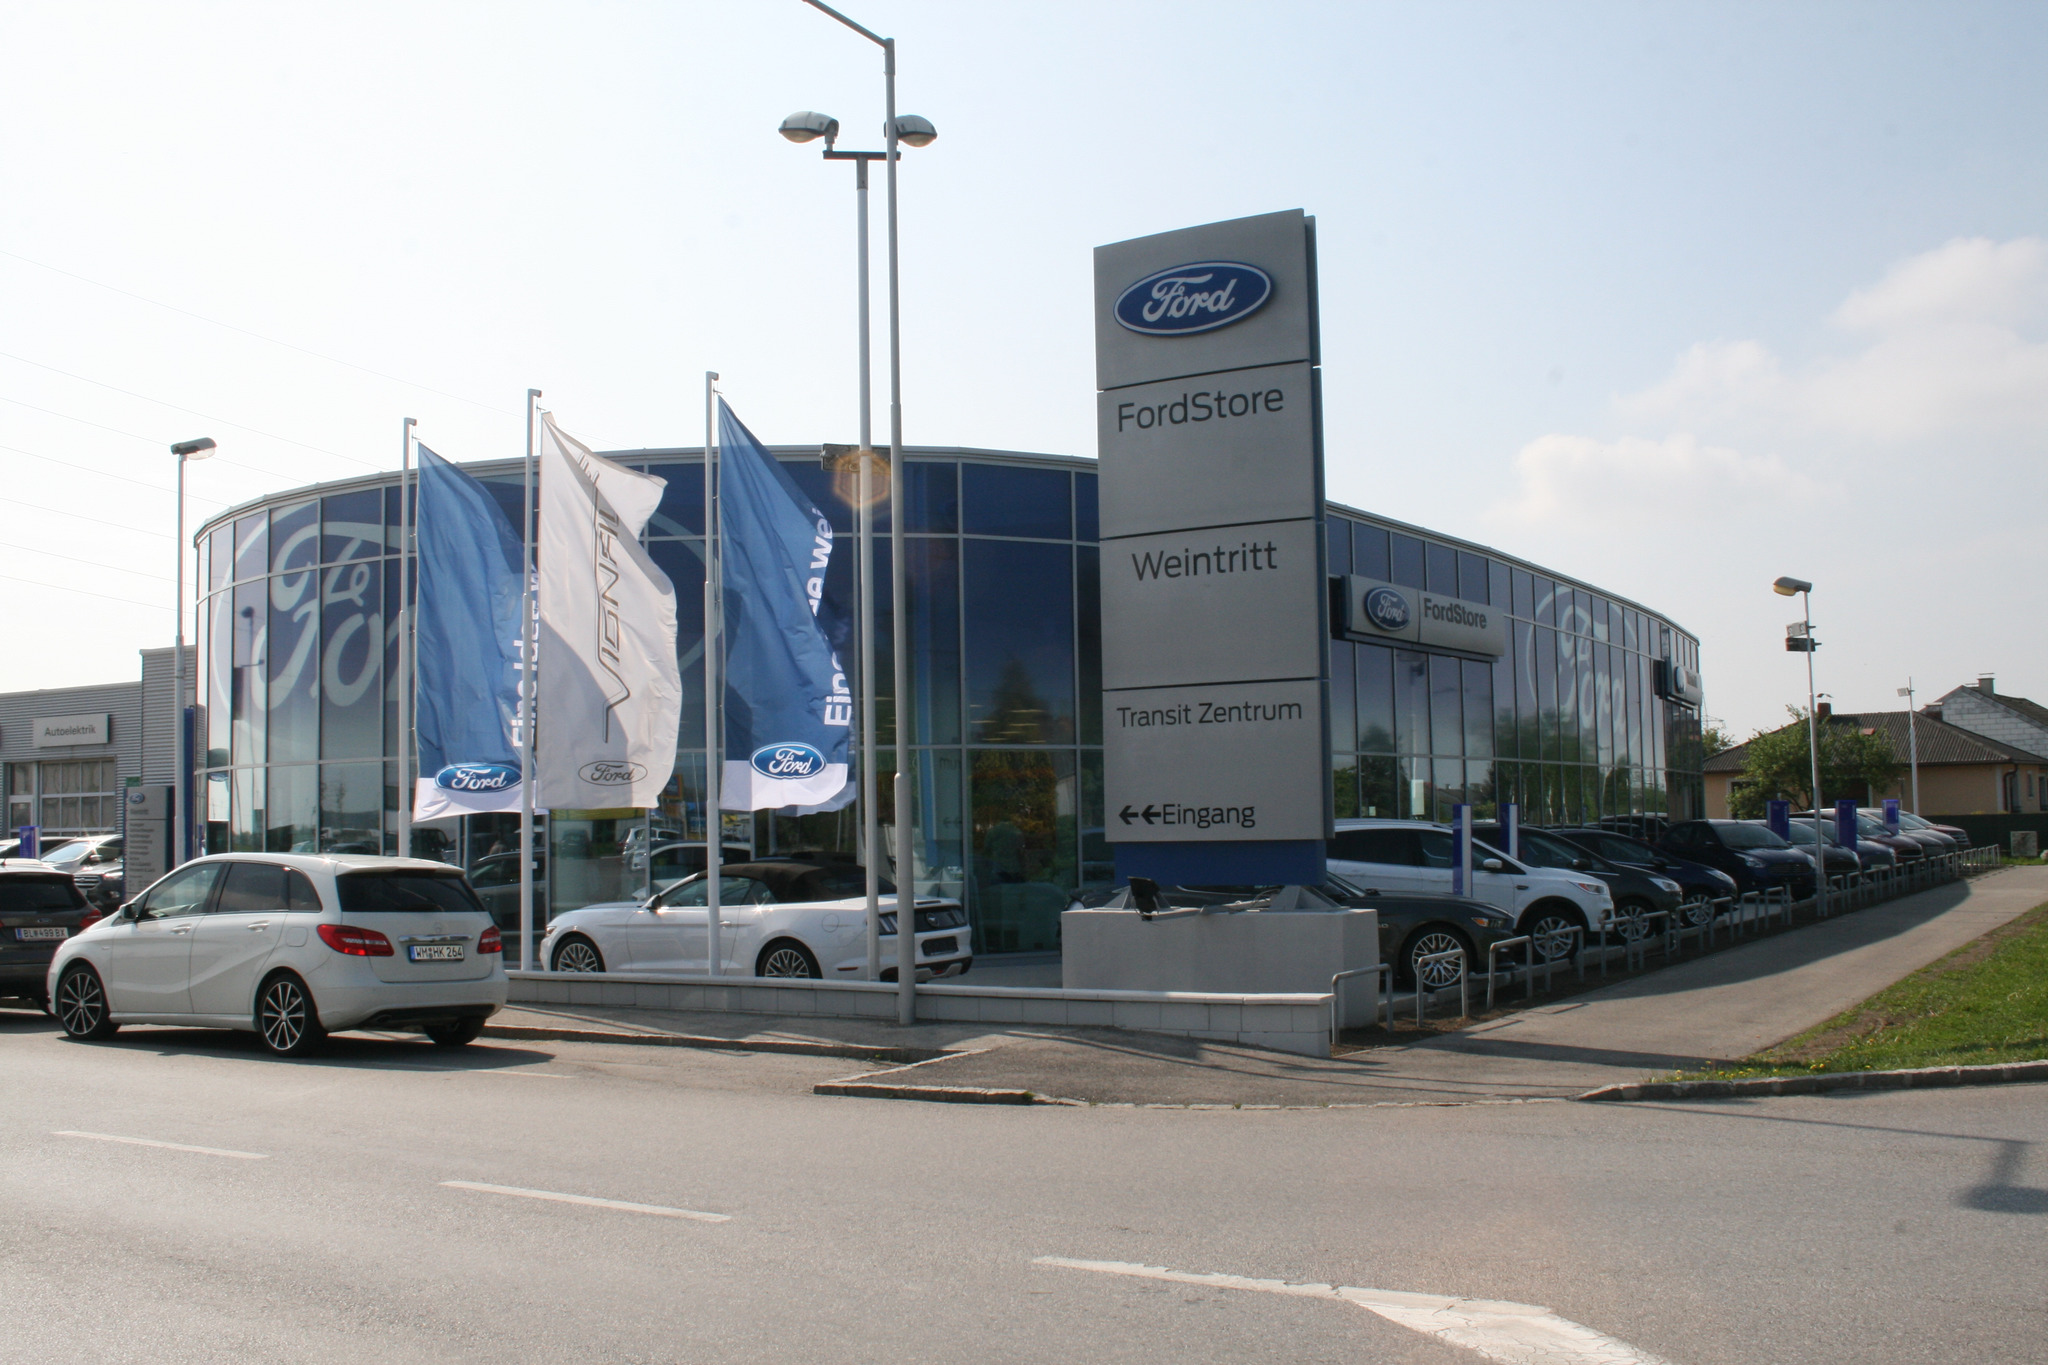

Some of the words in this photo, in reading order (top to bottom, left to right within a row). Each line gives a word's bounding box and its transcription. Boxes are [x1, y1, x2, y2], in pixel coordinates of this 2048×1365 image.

[1142, 273, 1238, 322] Ford
[1117, 387, 1285, 433] FordStore
[1131, 541, 1278, 582] Weintritt
[578, 451, 631, 744] VIGNAL
[1377, 593, 1406, 622] Ford
[1423, 597, 1488, 629] FordStore
[1116, 704, 1192, 728] Transit
[1198, 701, 1303, 724] Zentrum
[44, 724, 97, 738] Autoelektrik
[590, 763, 636, 783] Ford
[768, 747, 814, 775] Ford
[451, 768, 508, 790] Ford
[1162, 803, 1256, 829] Eingang
